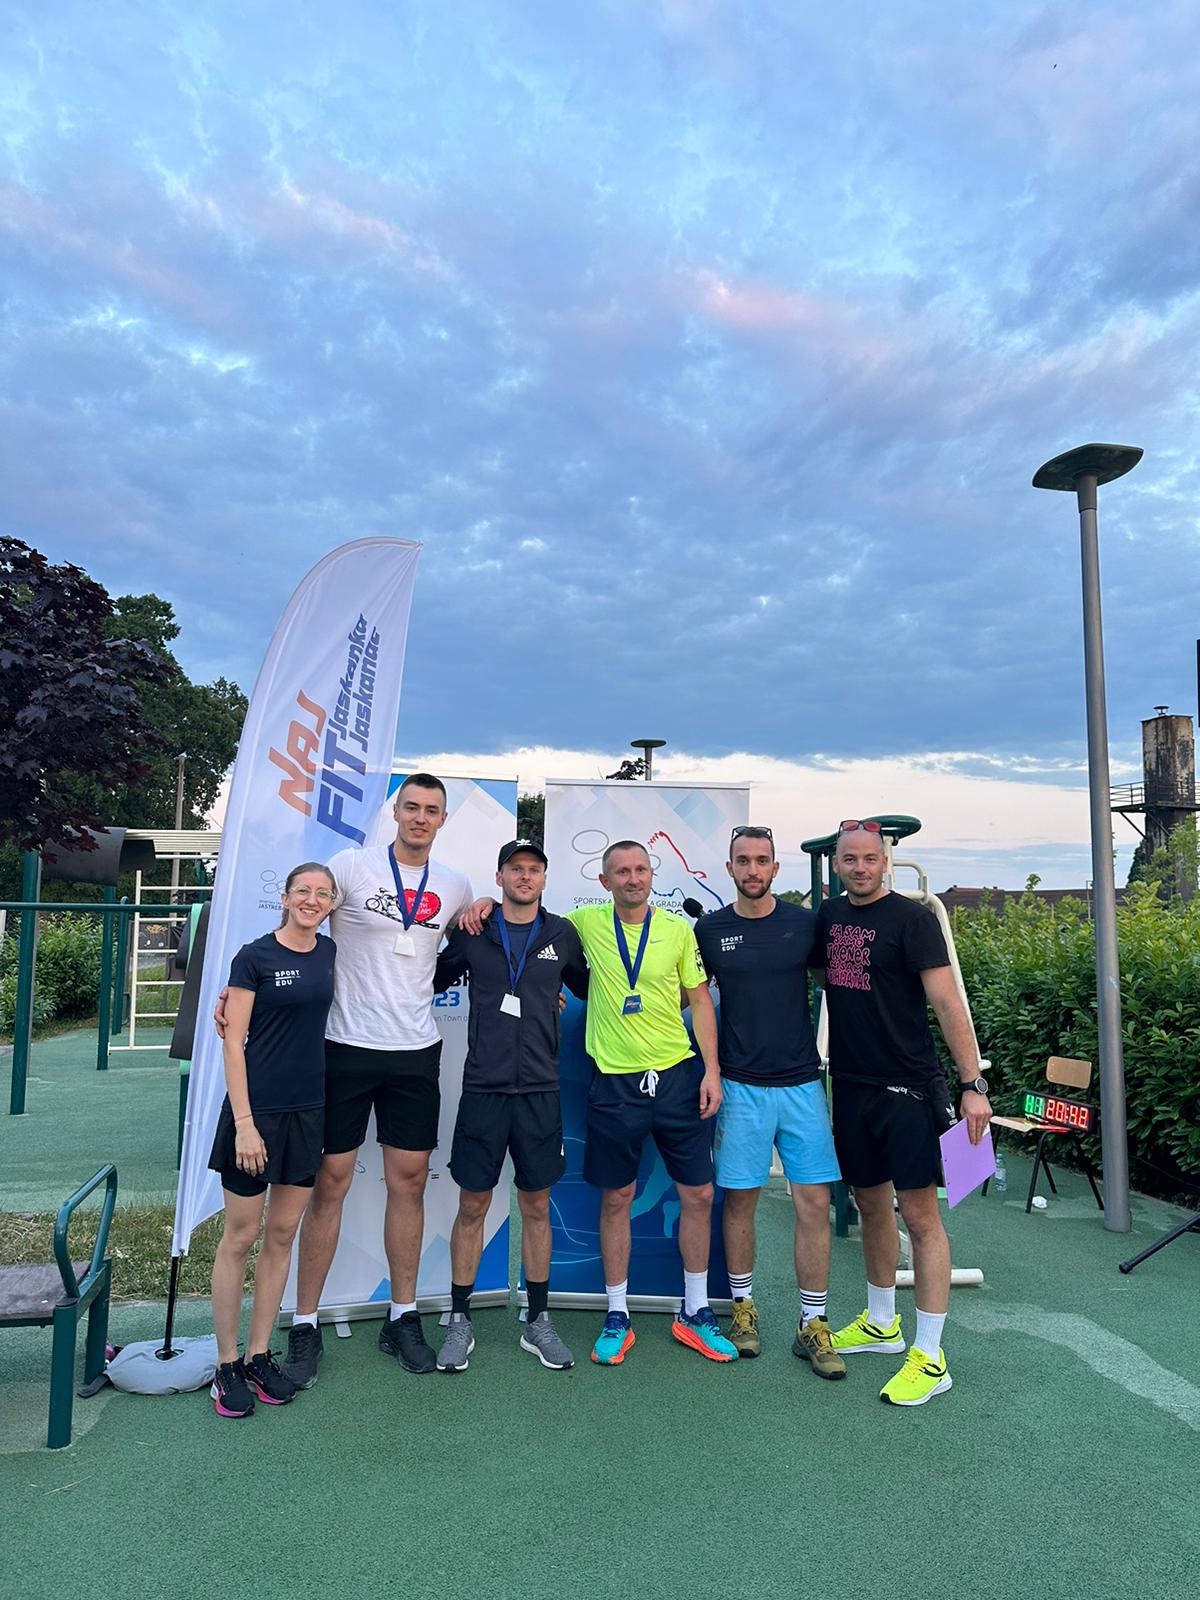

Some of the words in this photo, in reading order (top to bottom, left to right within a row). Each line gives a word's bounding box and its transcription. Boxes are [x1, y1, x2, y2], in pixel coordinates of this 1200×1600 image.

[328, 613, 368, 740] Jaskanka
[268, 689, 327, 817] NAJ
[317, 728, 367, 847] FIT
[573, 896, 613, 905] SPORTSKA
[656, 900, 683, 908] GRADA
[829, 924, 842, 937] JA
[844, 925, 876, 941] SAM
[720, 934, 744, 944] SPORT
[721, 944, 736, 952] EDU
[274, 969, 300, 978] SPORT
[275, 979, 293, 987] EDU
[432, 991, 461, 1007] 23
